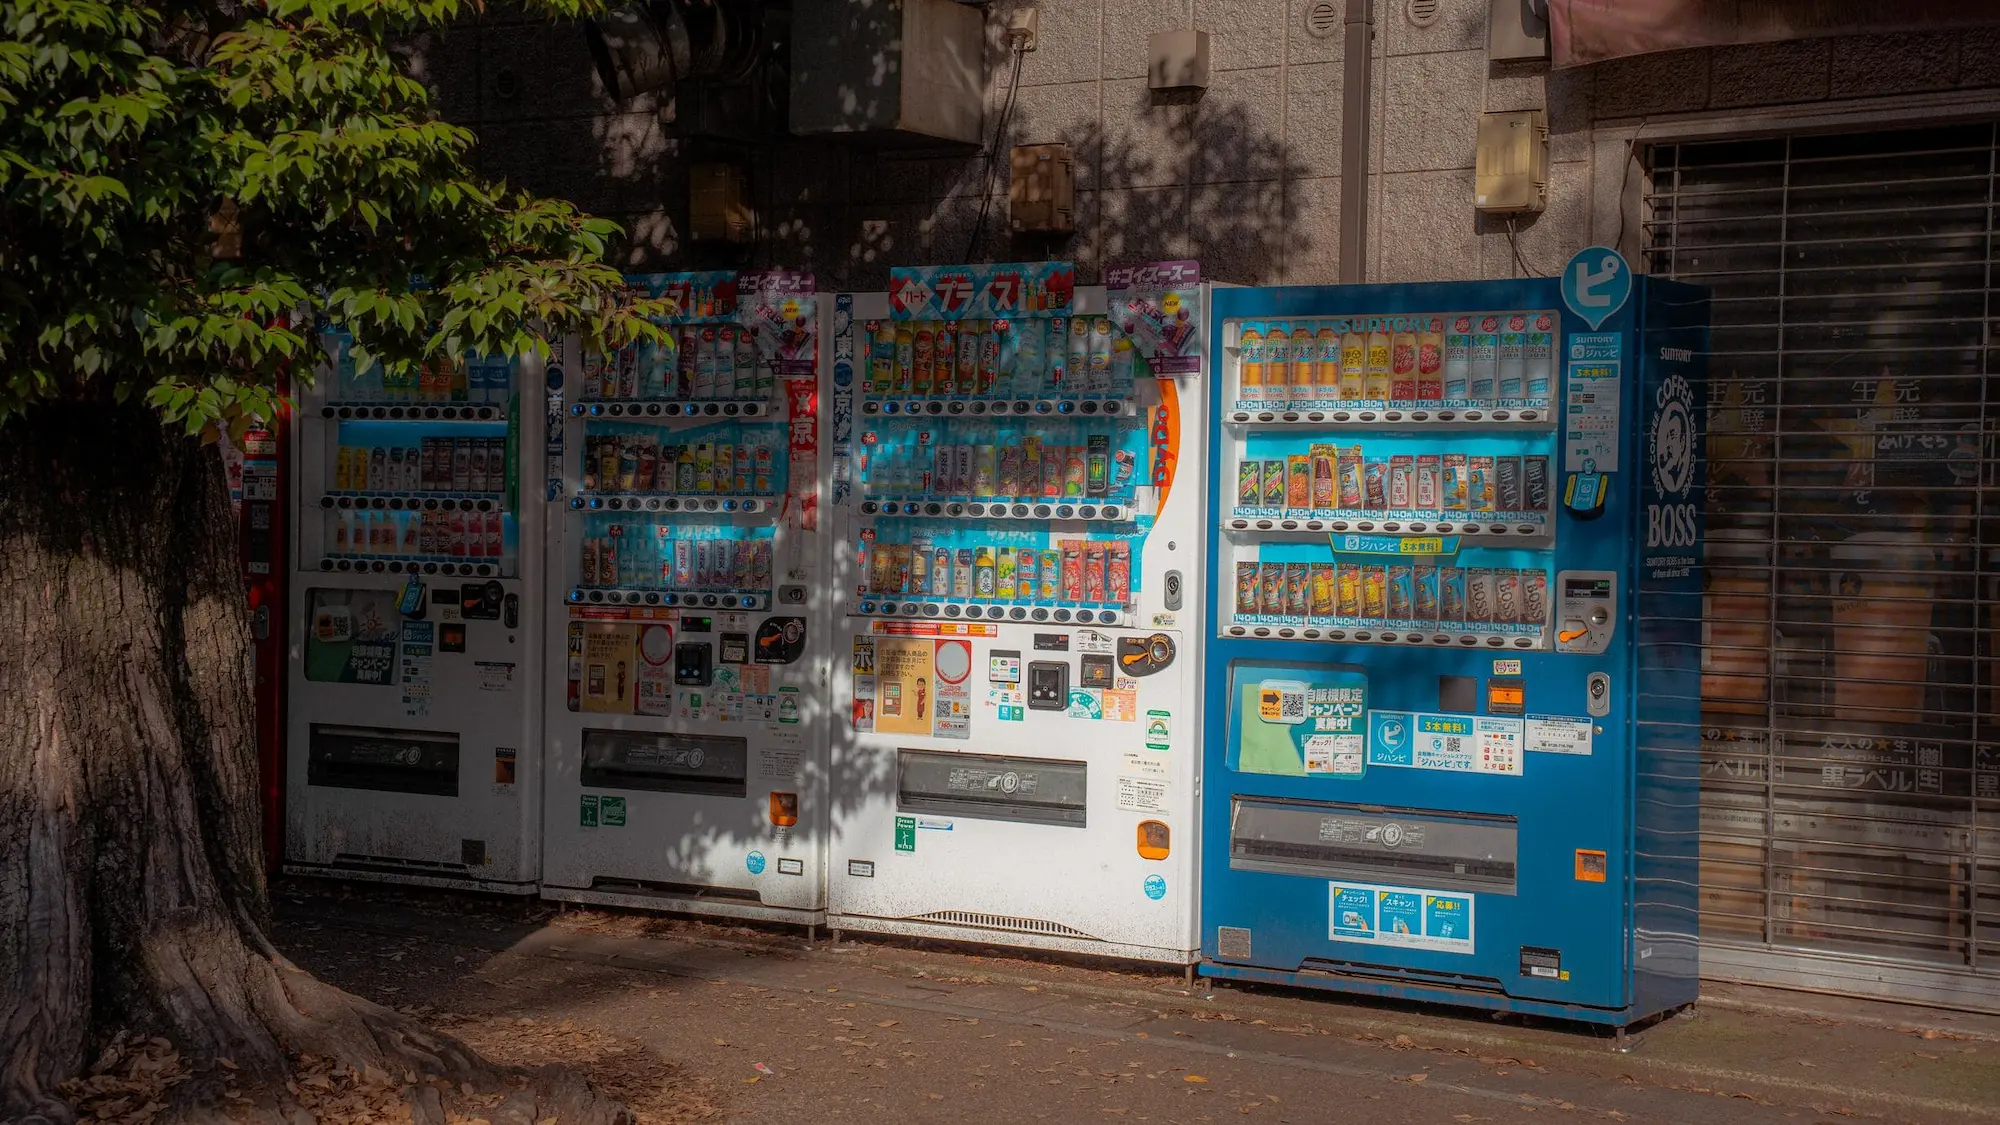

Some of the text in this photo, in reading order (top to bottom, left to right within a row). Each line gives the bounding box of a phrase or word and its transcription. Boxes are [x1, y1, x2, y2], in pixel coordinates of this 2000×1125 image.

[1576, 255, 1620, 307] ピ
[905, 291, 927, 303] ハート
[936, 280, 1013, 313] プライス
[1339, 316, 1433, 333] SUNTORY
[1586, 349, 1619, 358] ジハンピ
[1660, 347, 1692, 363] SUNTORY
[1656, 374, 1694, 411] COFFEE
[1153, 404, 1176, 487] DyDo
[1501, 463, 1519, 508] BLACK
[1528, 463, 1547, 507] BLACK
[1647, 503, 1697, 548] BOSS
[1360, 540, 1397, 551] ジハンピ
[1402, 540, 1438, 551] 3本無料!
[1472, 580, 1489, 617] BOSS
[1499, 582, 1516, 619] BOSS
[1526, 582, 1544, 619] BOSS
[1308, 688, 1363, 702] 自販機限定
[1308, 703, 1363, 717] キャンペーン
[1315, 718, 1352, 730] 実施中!
[1424, 721, 1467, 733] 3本無料!
[1376, 753, 1407, 762] ジハンピ
[1822, 766, 1913, 792] 黒ラベル
[1341, 895, 1368, 904] チェック!
[1386, 899, 1415, 908] スキャン!
